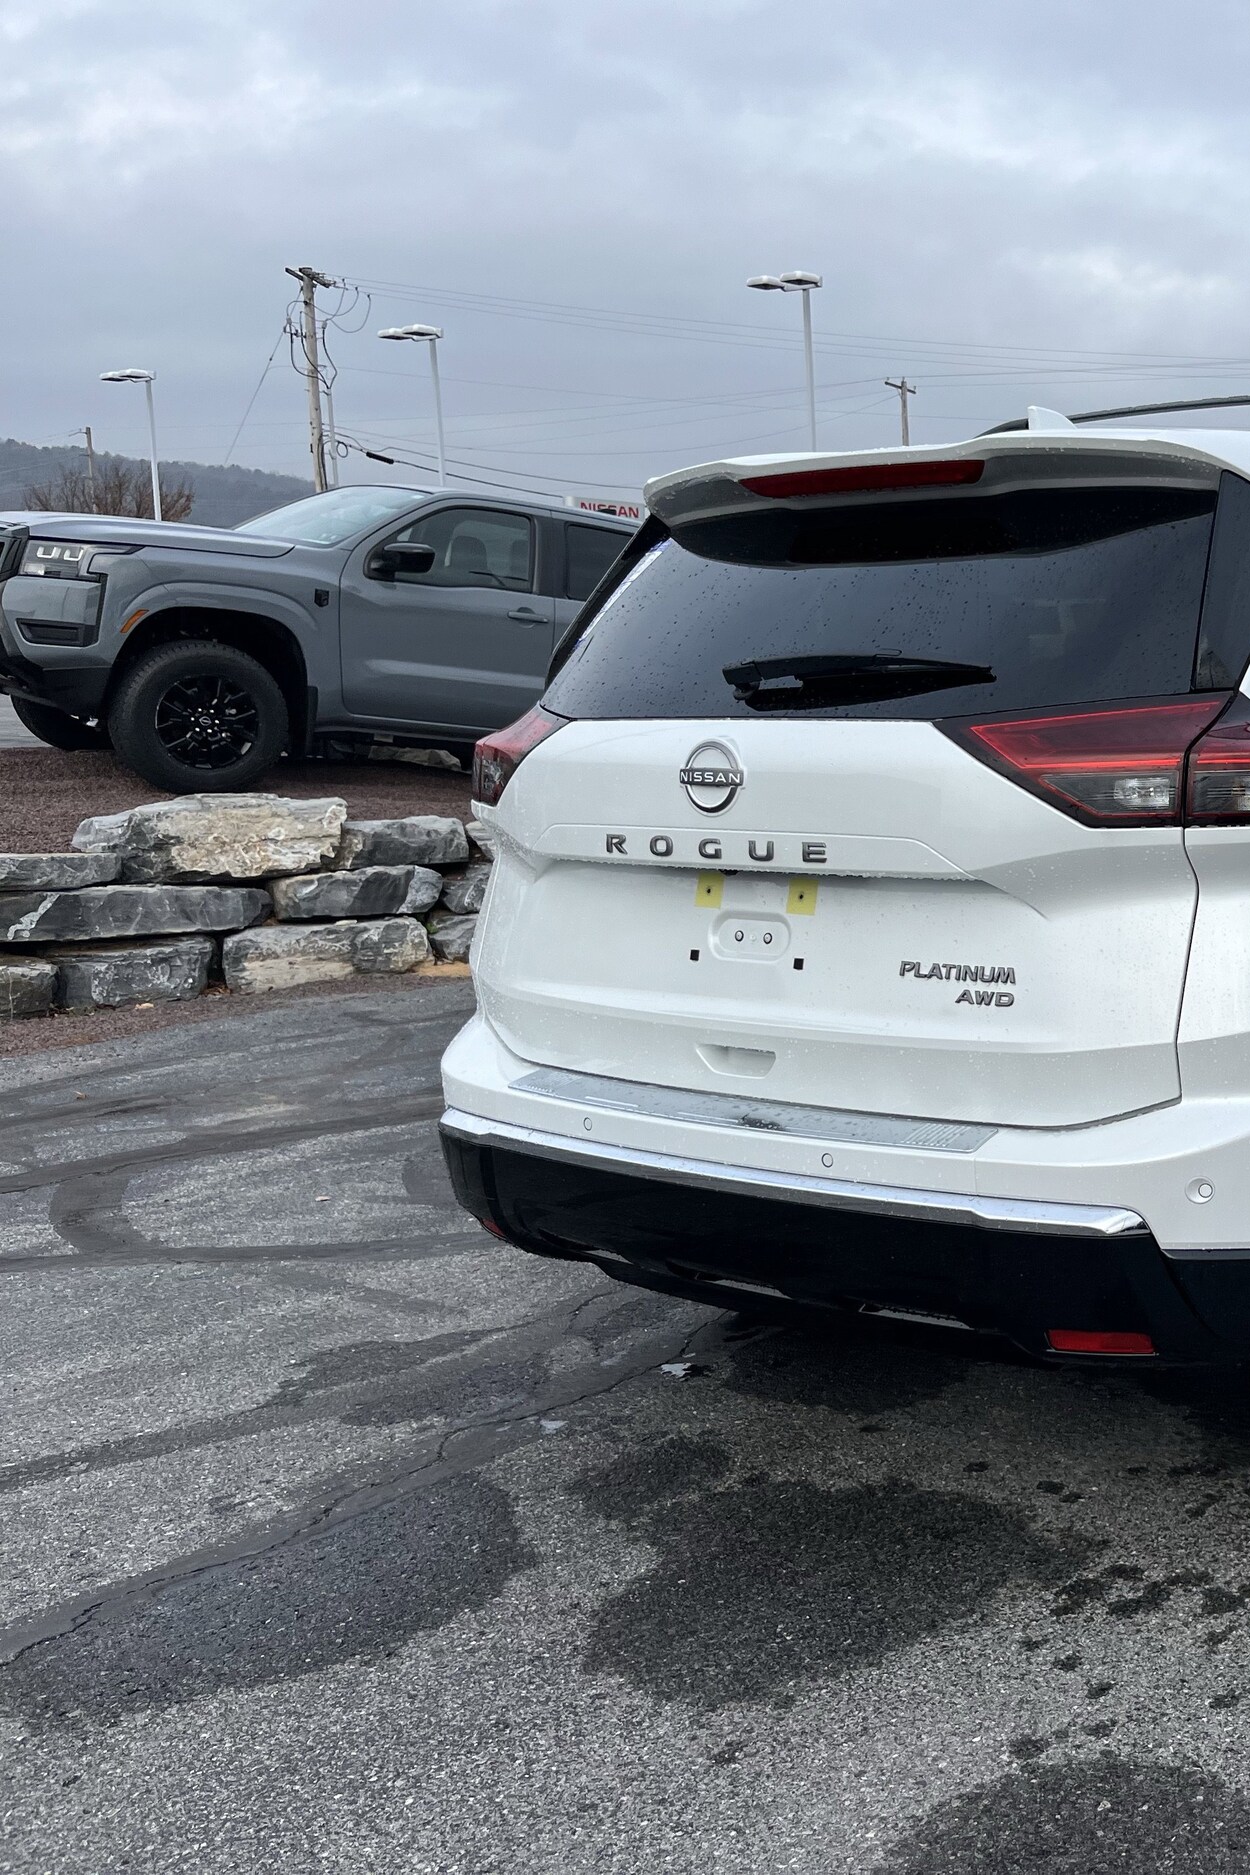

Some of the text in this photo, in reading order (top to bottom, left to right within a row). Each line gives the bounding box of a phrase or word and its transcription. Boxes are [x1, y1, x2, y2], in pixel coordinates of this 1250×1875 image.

[680, 771, 741, 784] NISSAN
[605, 833, 828, 863] ROGUE
[899, 960, 1016, 984] PLATINUM
[955, 989, 1015, 1007] AWD
